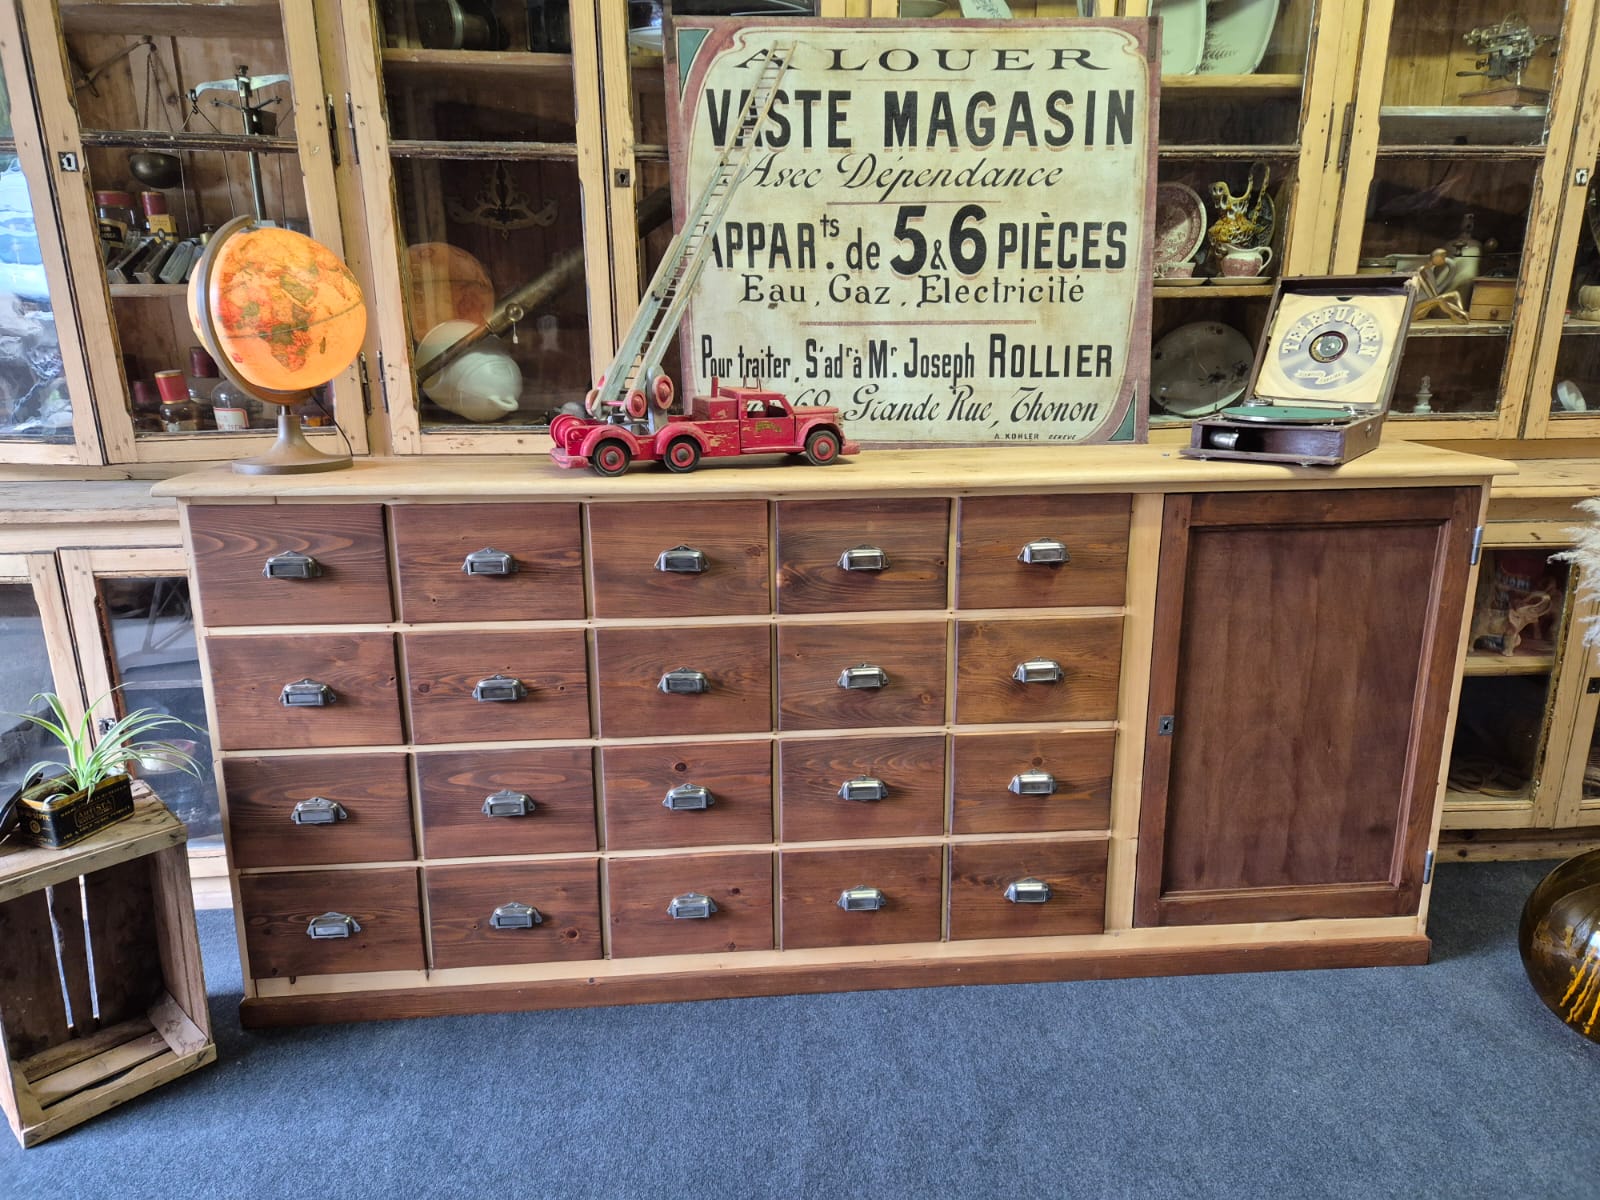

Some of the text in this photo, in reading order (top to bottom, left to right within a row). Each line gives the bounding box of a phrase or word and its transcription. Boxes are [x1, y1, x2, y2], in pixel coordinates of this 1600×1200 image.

[824, 48, 1110, 72] LOUER
[705, 88, 1134, 148] VASTE MAGASIN
[836, 153, 1064, 204] Dépendance
[845, 227, 880, 270] de
[997, 211, 1127, 269] PIÈCES
[916, 274, 1085, 309] Electricité
[1282, 306, 1378, 357] TELEFUNKEN
[701, 334, 733, 378] Pour
[903, 337, 975, 394] Joseph
[989, 333, 1113, 378] ROLLIER
[843, 383, 940, 422] Grande
[1010, 386, 1099, 423] Thonon
